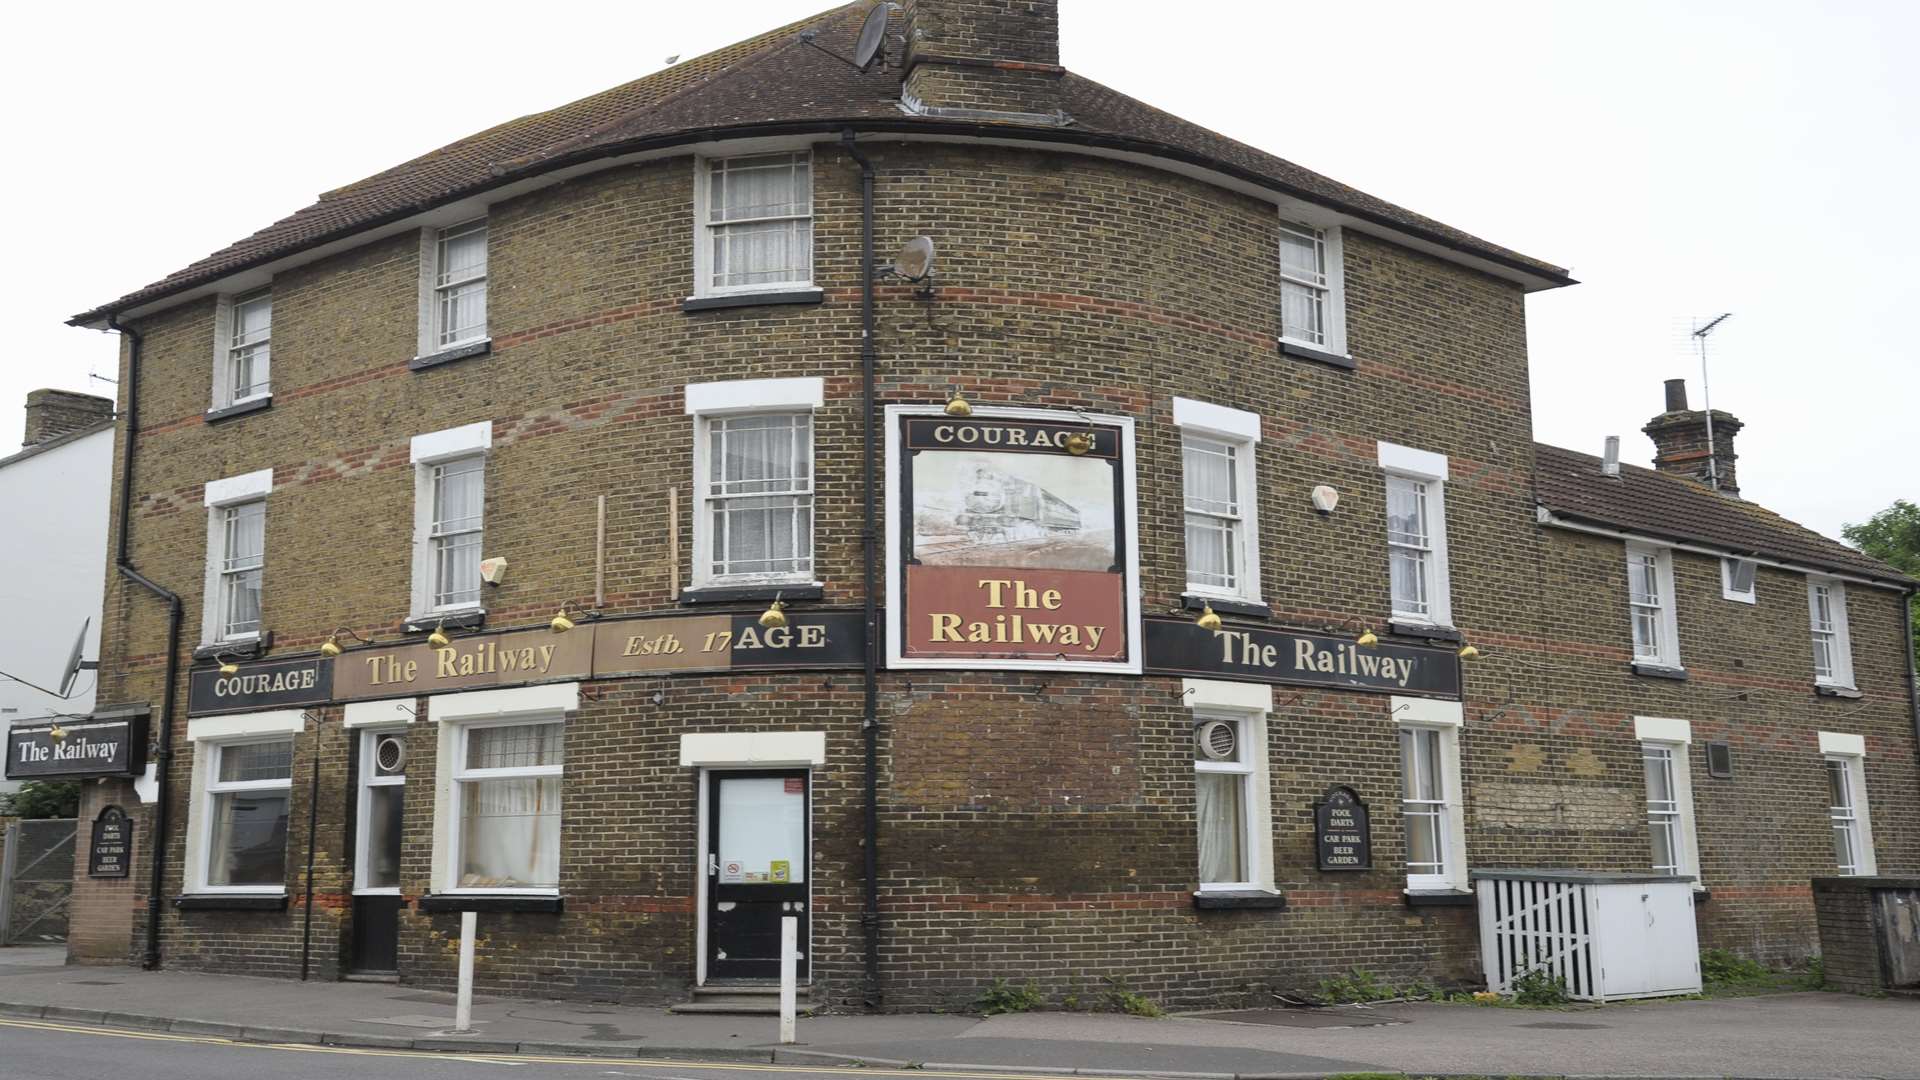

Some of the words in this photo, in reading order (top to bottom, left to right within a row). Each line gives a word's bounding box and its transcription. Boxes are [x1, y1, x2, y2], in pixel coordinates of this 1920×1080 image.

[979, 579, 1061, 610] The
[623, 634, 685, 656] Estb.
[928, 612, 1105, 651] Railway
[366, 655, 418, 686] The
[435, 642, 556, 679] Railway
[1214, 630, 1277, 667] The
[1294, 638, 1413, 687] Railway
[214, 669, 315, 697] COURAGE
[18, 740, 49, 762] The
[53, 737, 118, 762] Railway
[1330, 819, 1354, 827] DARTS
[1342, 835, 1361, 843] PARK
